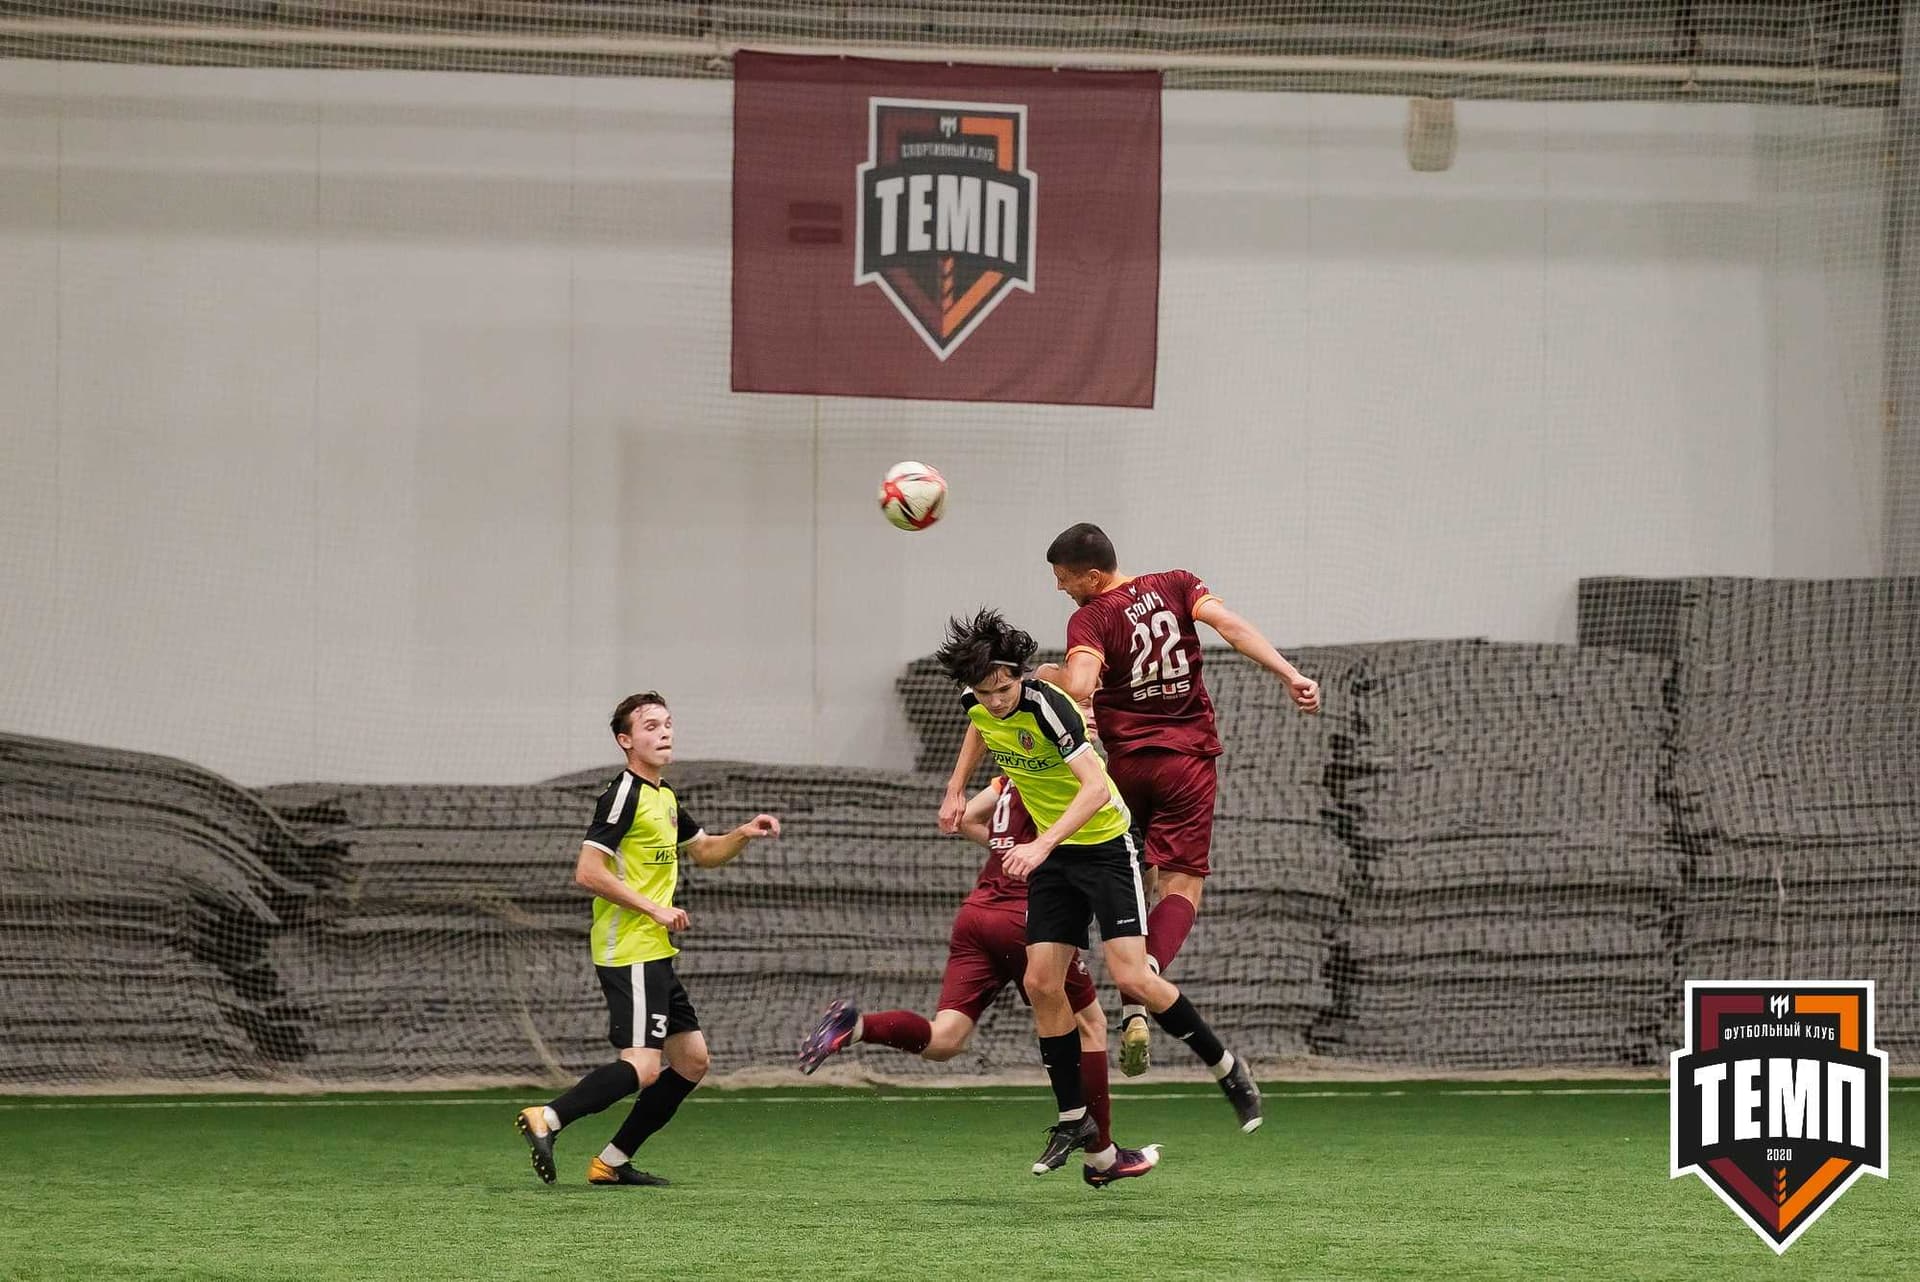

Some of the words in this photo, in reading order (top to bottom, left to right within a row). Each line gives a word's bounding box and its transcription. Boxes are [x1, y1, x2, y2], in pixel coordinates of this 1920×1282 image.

[875, 174, 1019, 264] ТЕМП
[1129, 610, 1190, 688] 22
[1132, 680, 1190, 701] SEUS
[651, 1013, 667, 1038] 3
